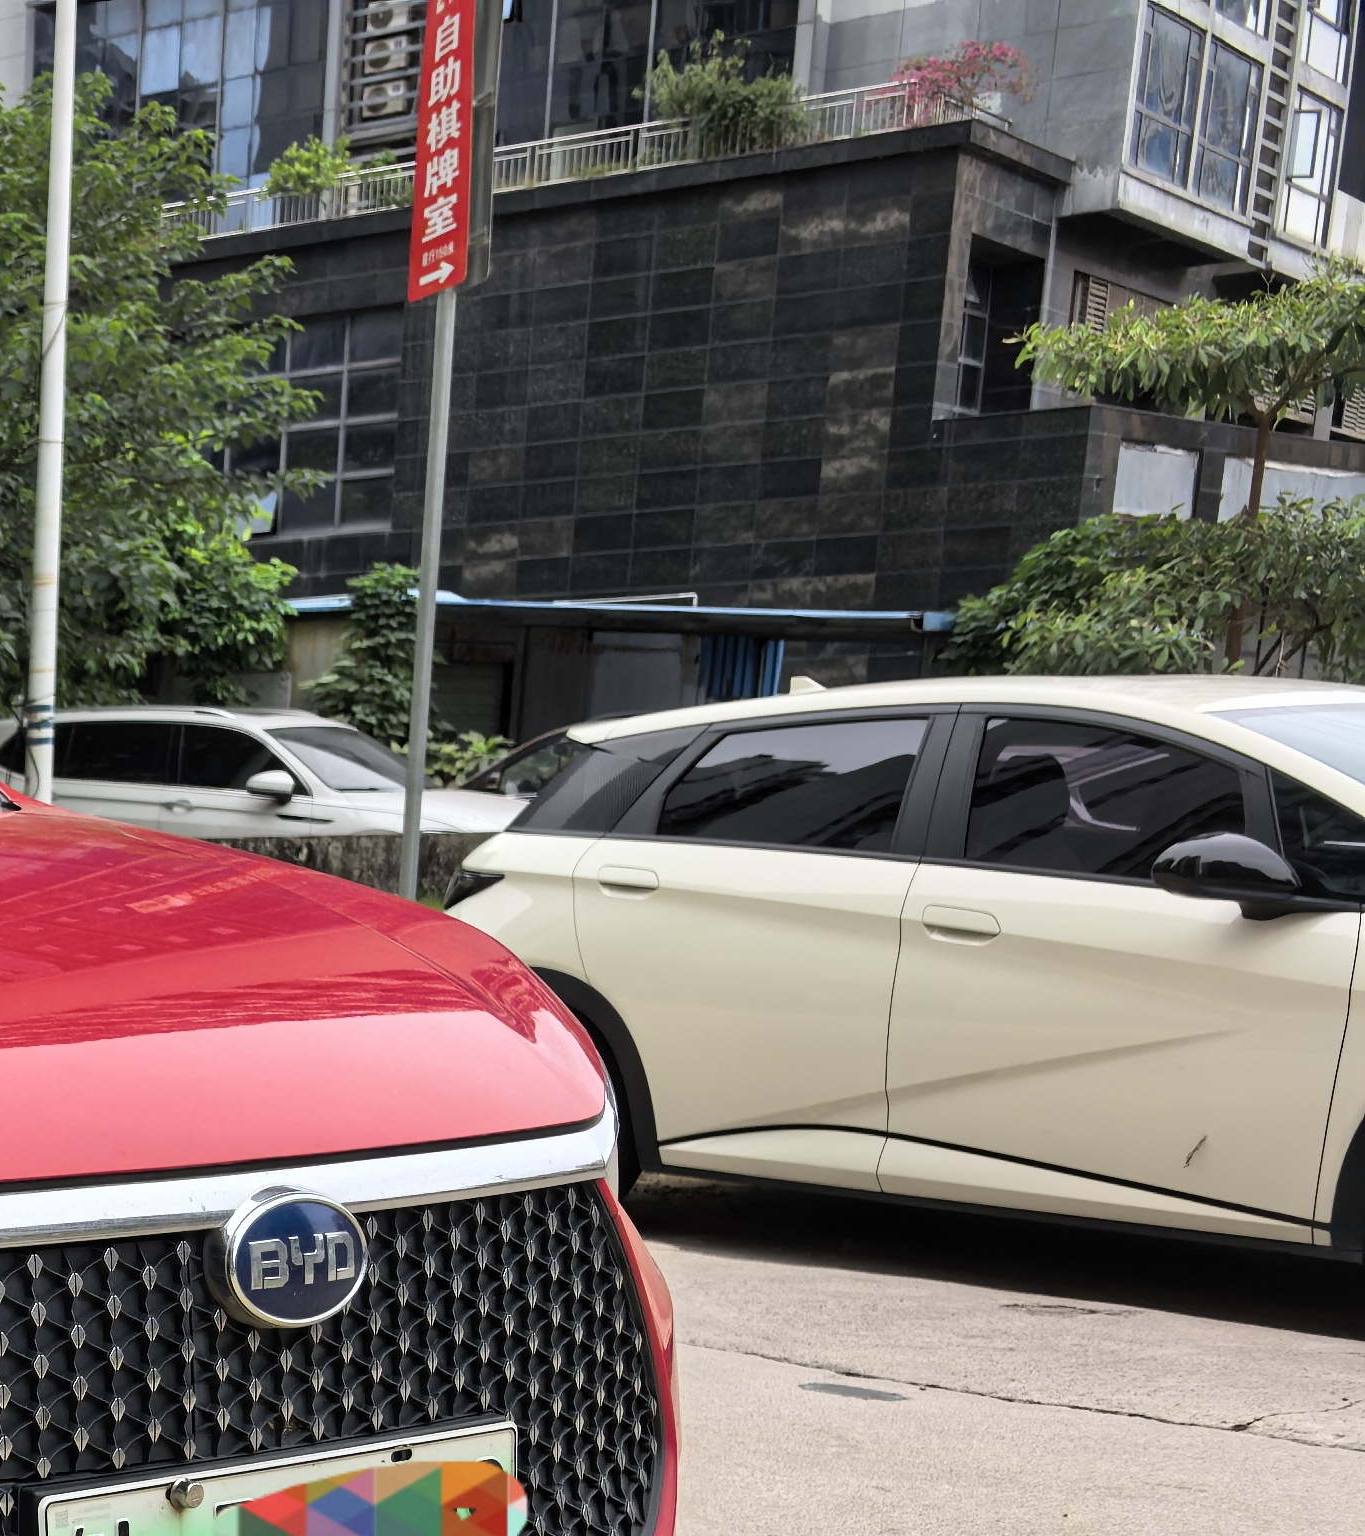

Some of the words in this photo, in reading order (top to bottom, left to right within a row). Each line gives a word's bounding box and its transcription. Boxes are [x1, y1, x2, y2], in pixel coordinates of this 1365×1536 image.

[421, 0, 462, 243] 自助棋牌室
[248, 1231, 357, 1291] BYD
